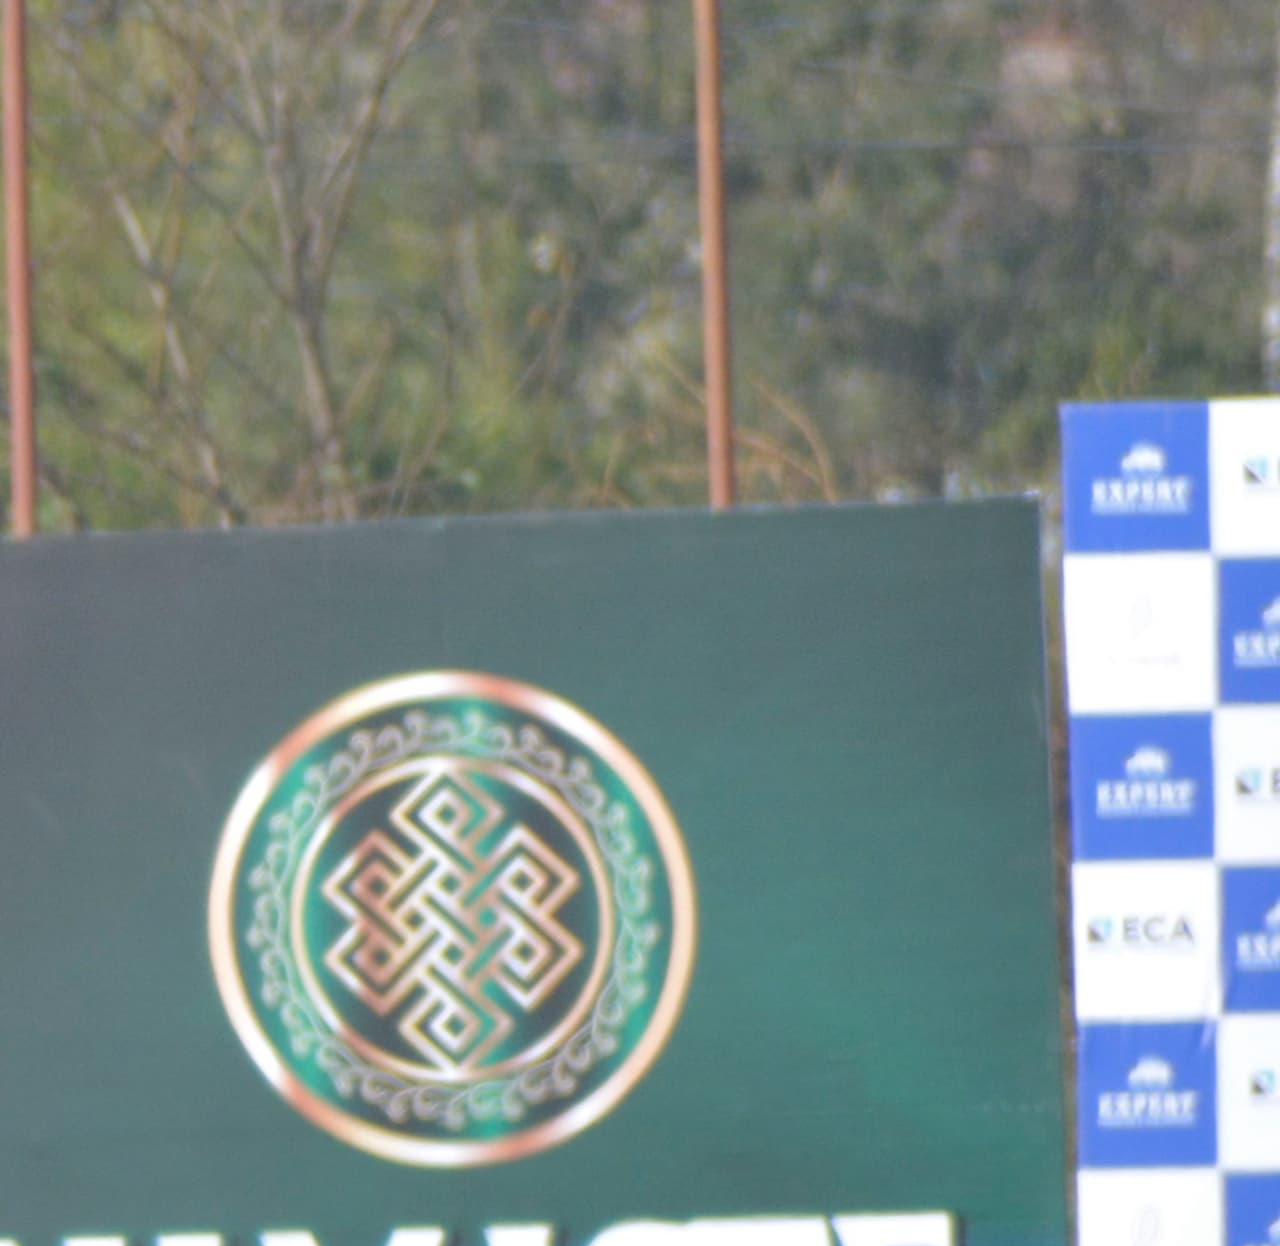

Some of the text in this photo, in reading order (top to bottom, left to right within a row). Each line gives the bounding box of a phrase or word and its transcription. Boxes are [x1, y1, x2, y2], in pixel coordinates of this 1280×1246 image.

[1092, 477, 1191, 502] EXPERT
[1097, 781, 1196, 807] EXPERT
[1122, 916, 1195, 943] ECA
[1099, 1090, 1199, 1117] EXPERT
